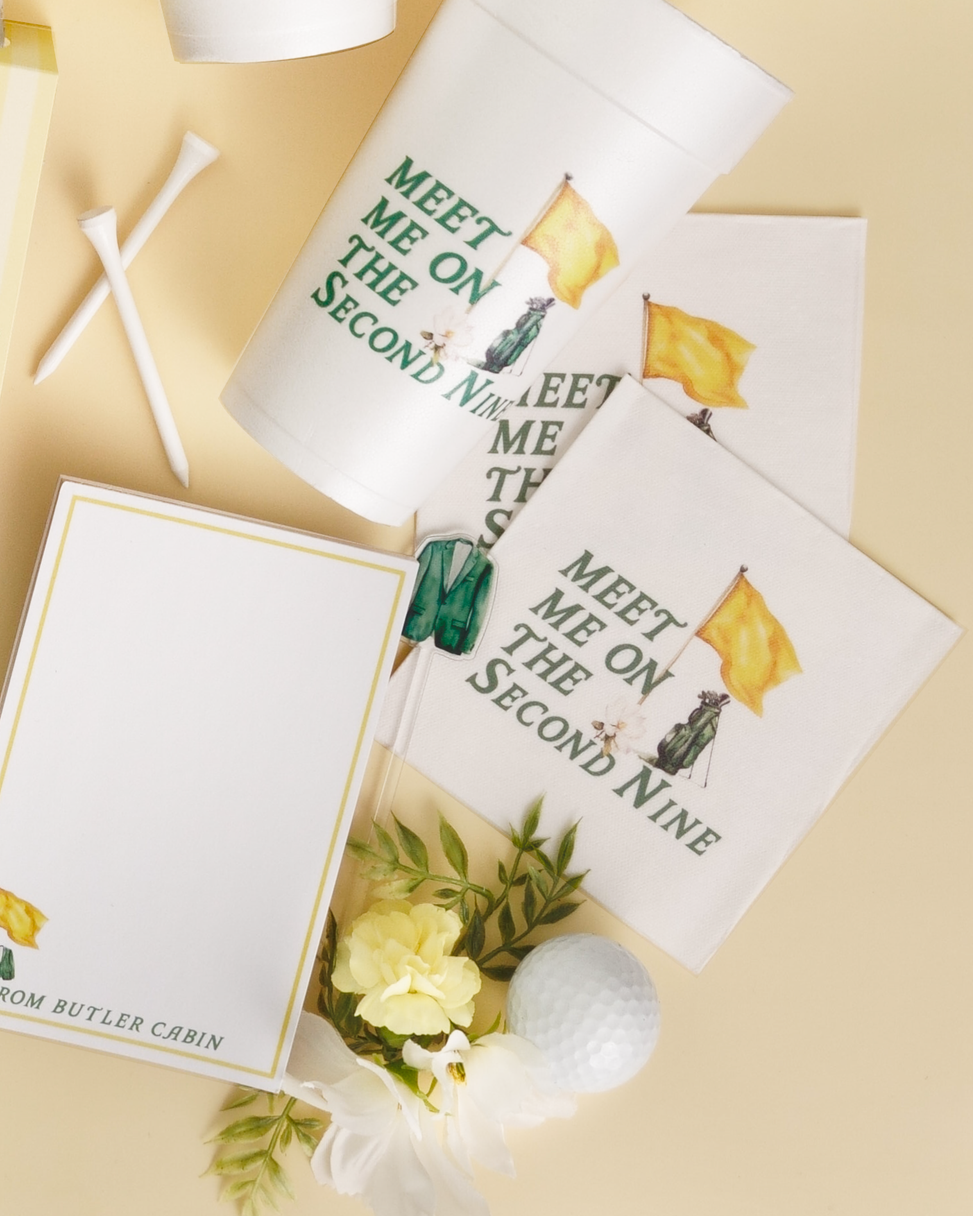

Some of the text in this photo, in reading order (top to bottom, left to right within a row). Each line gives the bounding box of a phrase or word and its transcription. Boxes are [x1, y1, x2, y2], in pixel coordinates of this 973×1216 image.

[384, 155, 513, 251] MEET
[338, 234, 419, 307] THE
[361, 196, 502, 307] ME ON
[310, 270, 445, 386] SECOND
[487, 419, 565, 456] ME
[486, 466, 553, 503] TH
[529, 587, 676, 696] ME ON
[558, 549, 688, 642] MEET
[500, 623, 593, 696] THE
[465, 657, 722, 856] SECOND NINE
[51, 998, 144, 1033] BUTLER
[151, 1022, 225, 1052] CABIN
